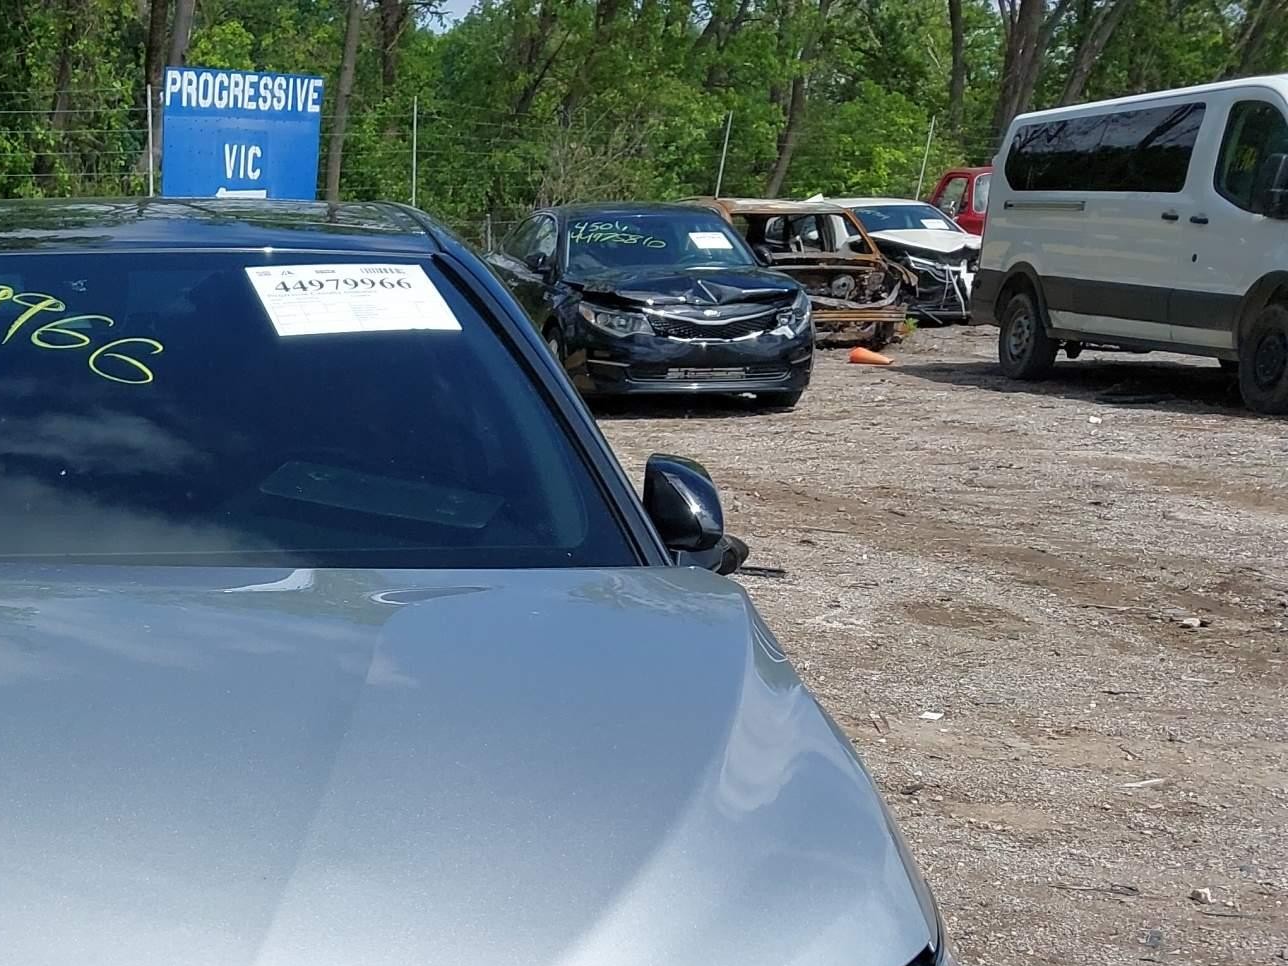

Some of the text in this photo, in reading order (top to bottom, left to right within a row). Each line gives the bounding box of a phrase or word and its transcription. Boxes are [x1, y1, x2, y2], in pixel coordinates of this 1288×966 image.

[165, 70, 324, 113] PROGRESSIVE
[224, 143, 262, 180] VIC
[274, 277, 413, 293] 44979966
